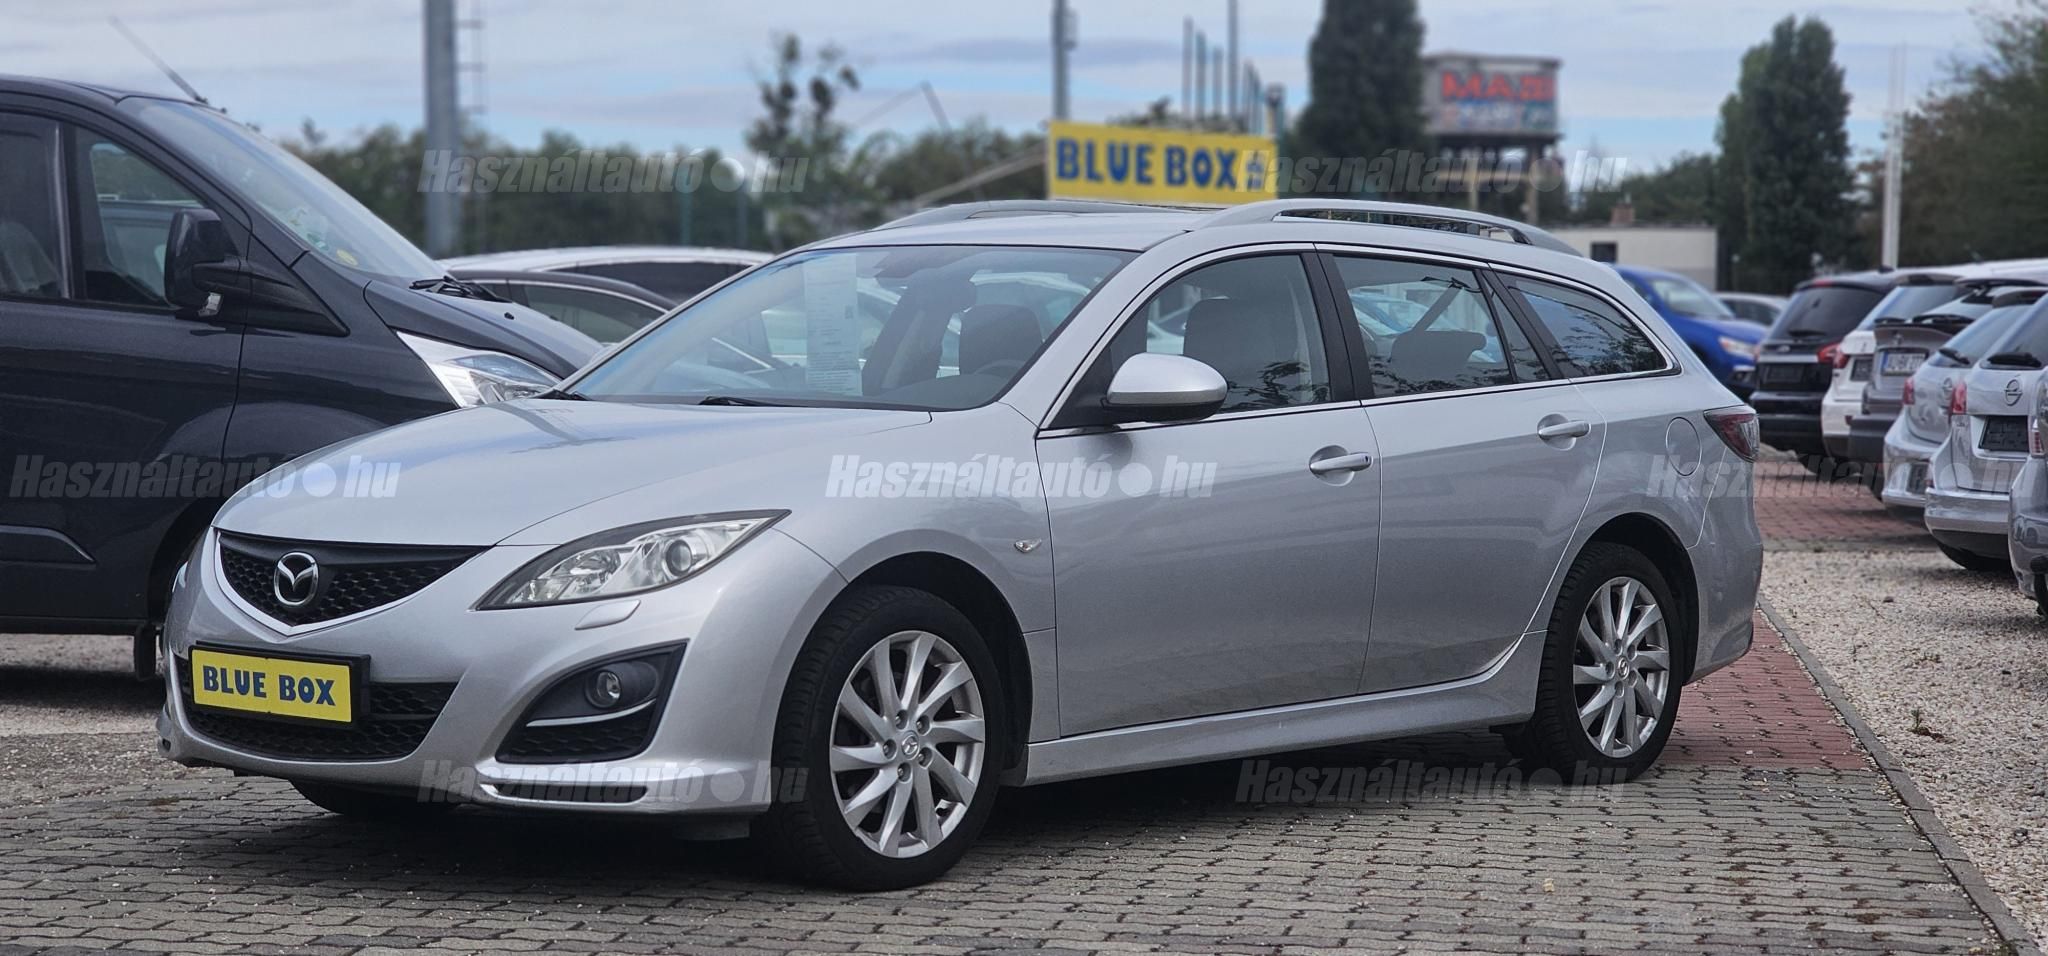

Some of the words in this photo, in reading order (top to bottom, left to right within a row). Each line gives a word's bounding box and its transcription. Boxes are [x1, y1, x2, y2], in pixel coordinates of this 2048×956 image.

[1055, 137, 1153, 187] BLUE
[1164, 145, 1238, 190] BOX
[202, 665, 267, 699] BLUE
[278, 674, 337, 706] BOX
